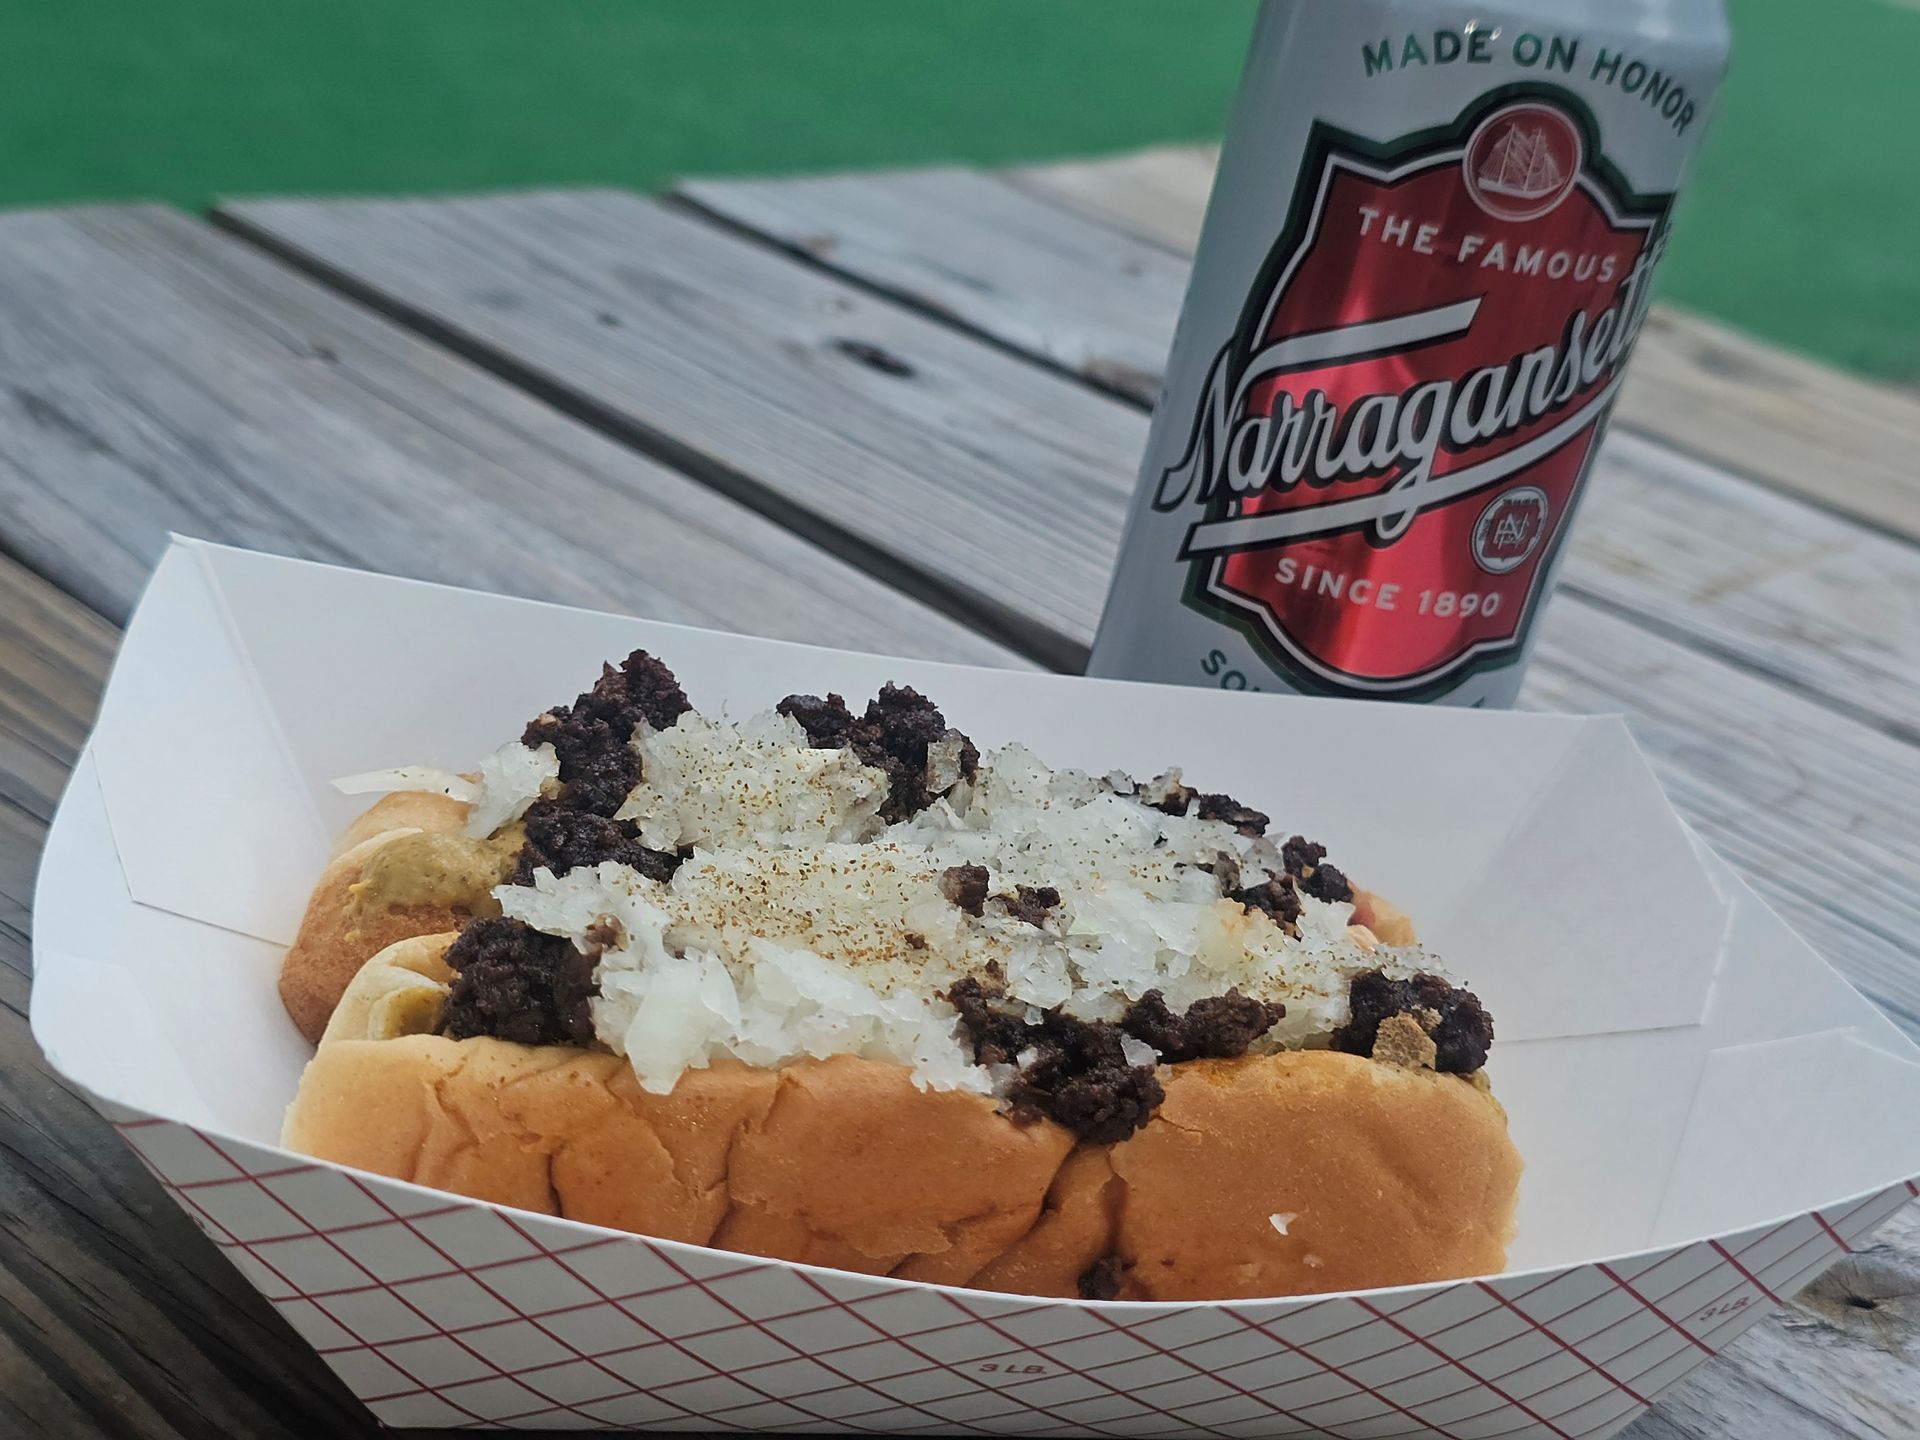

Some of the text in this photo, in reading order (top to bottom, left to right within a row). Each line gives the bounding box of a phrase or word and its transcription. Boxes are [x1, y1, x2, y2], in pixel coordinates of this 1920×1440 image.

[1361, 29, 1696, 137] MADE ON HONOR
[1358, 206, 1618, 283] THE FAMOUS
[1275, 557, 1501, 618] SINCE 1890
[979, 1363, 999, 1373] 3
